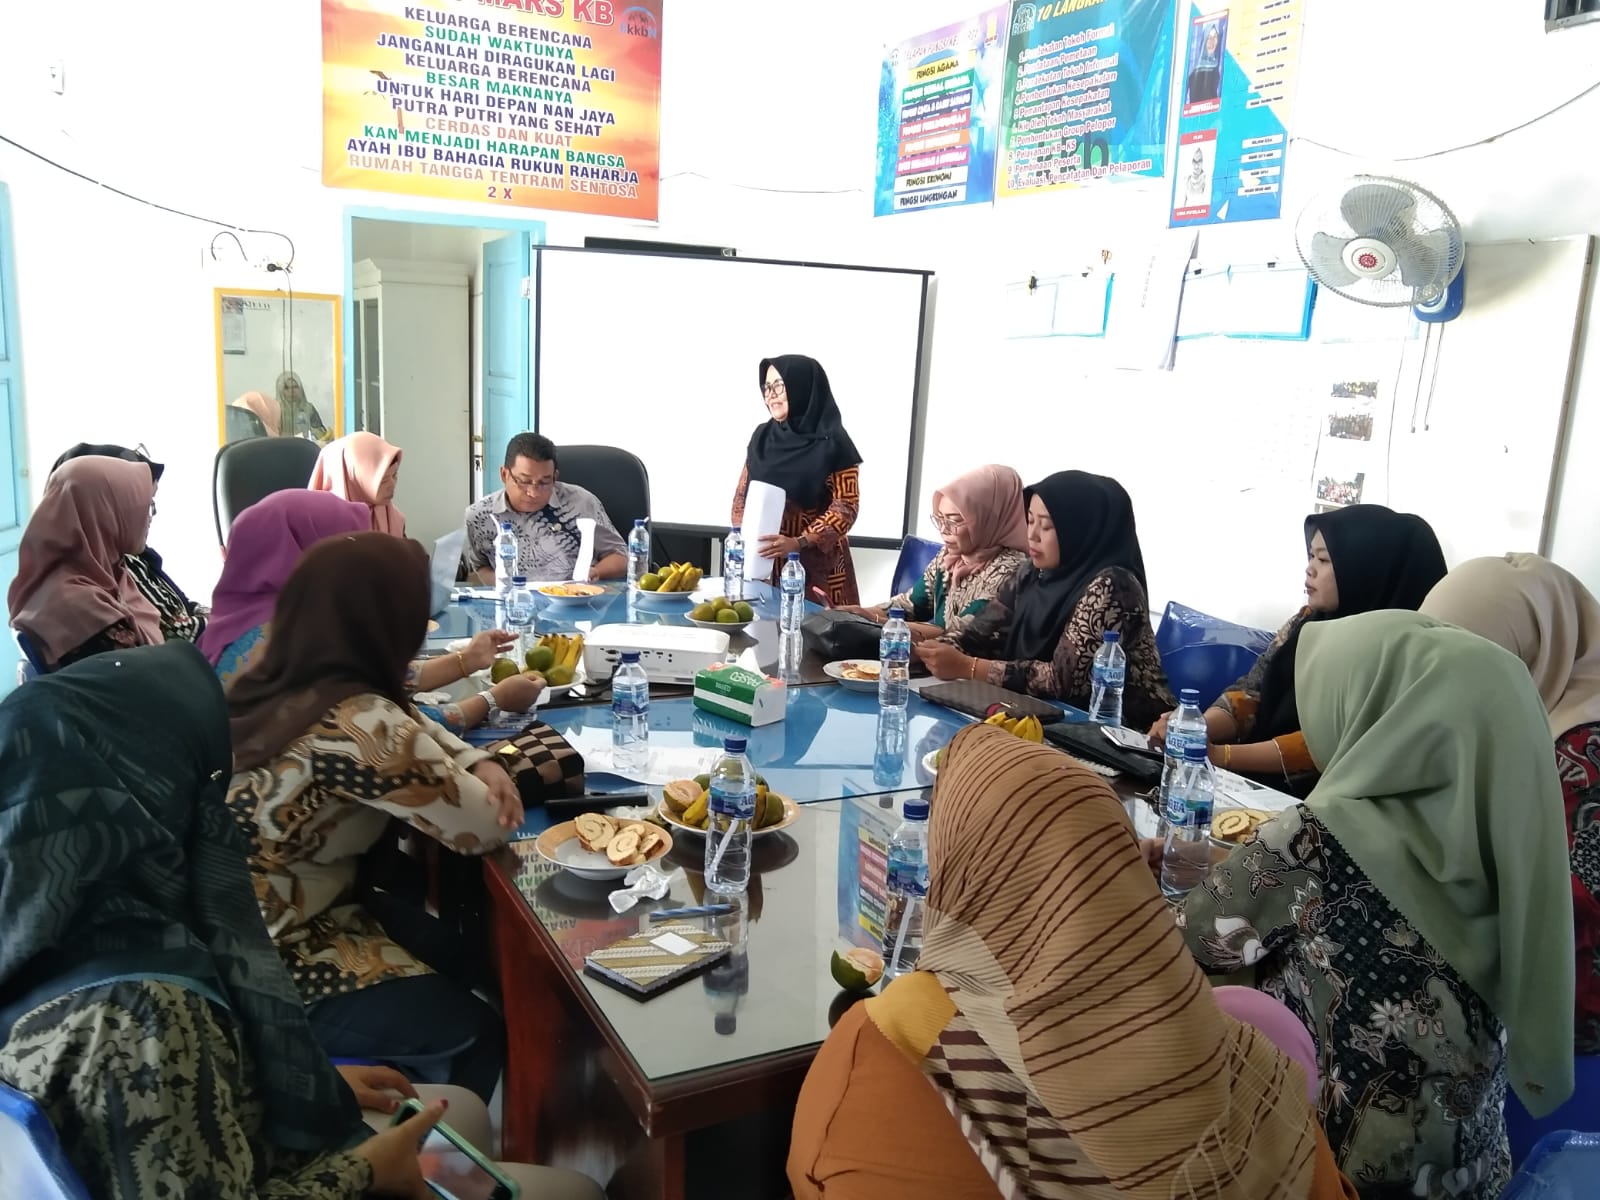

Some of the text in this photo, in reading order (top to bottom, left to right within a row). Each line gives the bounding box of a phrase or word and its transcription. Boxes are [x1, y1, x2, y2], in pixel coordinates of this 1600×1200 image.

[573, 0, 614, 24] KB
[1037, 0, 1105, 22] 10 LANG
[405, 6, 592, 49] KELUARGA BERENCANA
[425, 26, 574, 60] SUDAH WAKTUNYA
[1064, 31, 1085, 47] Tokoh
[377, 33, 616, 82] JANGANLAH DIRAGUKAN LAGI
[405, 53, 592, 93] KELUARGA BERENCANA
[377, 79, 616, 125] UNTUK HARI DEPAN NAN JAYA
[426, 71, 573, 105] BESAR MAKNANYA
[1061, 89, 1110, 107] Kesepakatan
[392, 97, 602, 137] PUTRA PUTRI YANG SEHAT
[1067, 102, 1111, 121] Masyarakat
[425, 117, 573, 148] CERDAS DAN KUAT
[1063, 125, 1085, 138] Group
[1086, 118, 1116, 133] Pelopor
[347, 138, 639, 184] AYAH IBU BAHAGIA RUKUN RAHARJA
[364, 125, 625, 168] KAN MENJADI HARAPAN BANGSA
[1051, 143, 1062, 154] KB
[1066, 139, 1077, 151] KS
[349, 154, 637, 198] RUMAH TANGGA TENTRAM SENTOSA
[1015, 160, 1052, 174] Pembinaan
[1053, 154, 1081, 168] Peserta
[1049, 169, 1091, 184] Pencatatan
[1092, 166, 1107, 177] Dan
[1109, 160, 1151, 173] Pelaporan
[487, 186, 512, 199] 2 X
